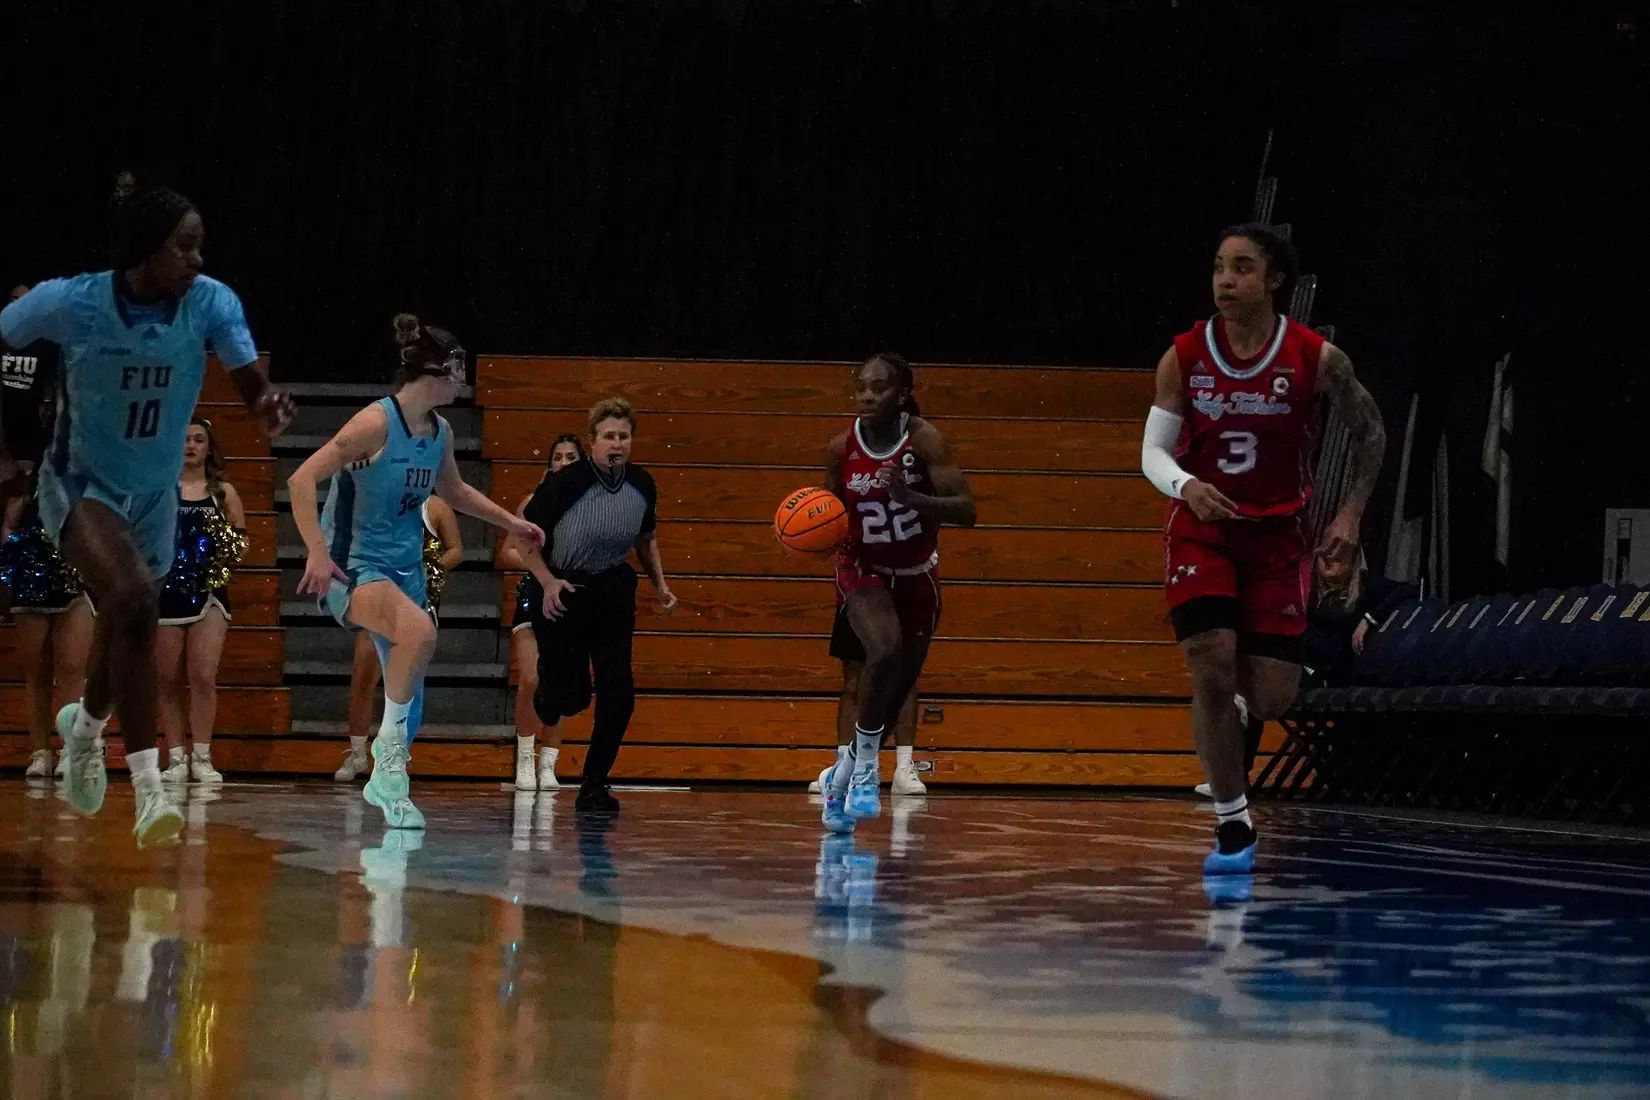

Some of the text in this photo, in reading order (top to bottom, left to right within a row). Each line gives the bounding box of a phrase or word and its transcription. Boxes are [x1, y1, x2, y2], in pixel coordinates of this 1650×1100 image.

[1, 353, 38, 374] FIU
[120, 365, 172, 390] FIU
[124, 400, 160, 439] 10
[1217, 430, 1258, 475] 3
[403, 467, 432, 488] FIU
[856, 501, 923, 544] 22
